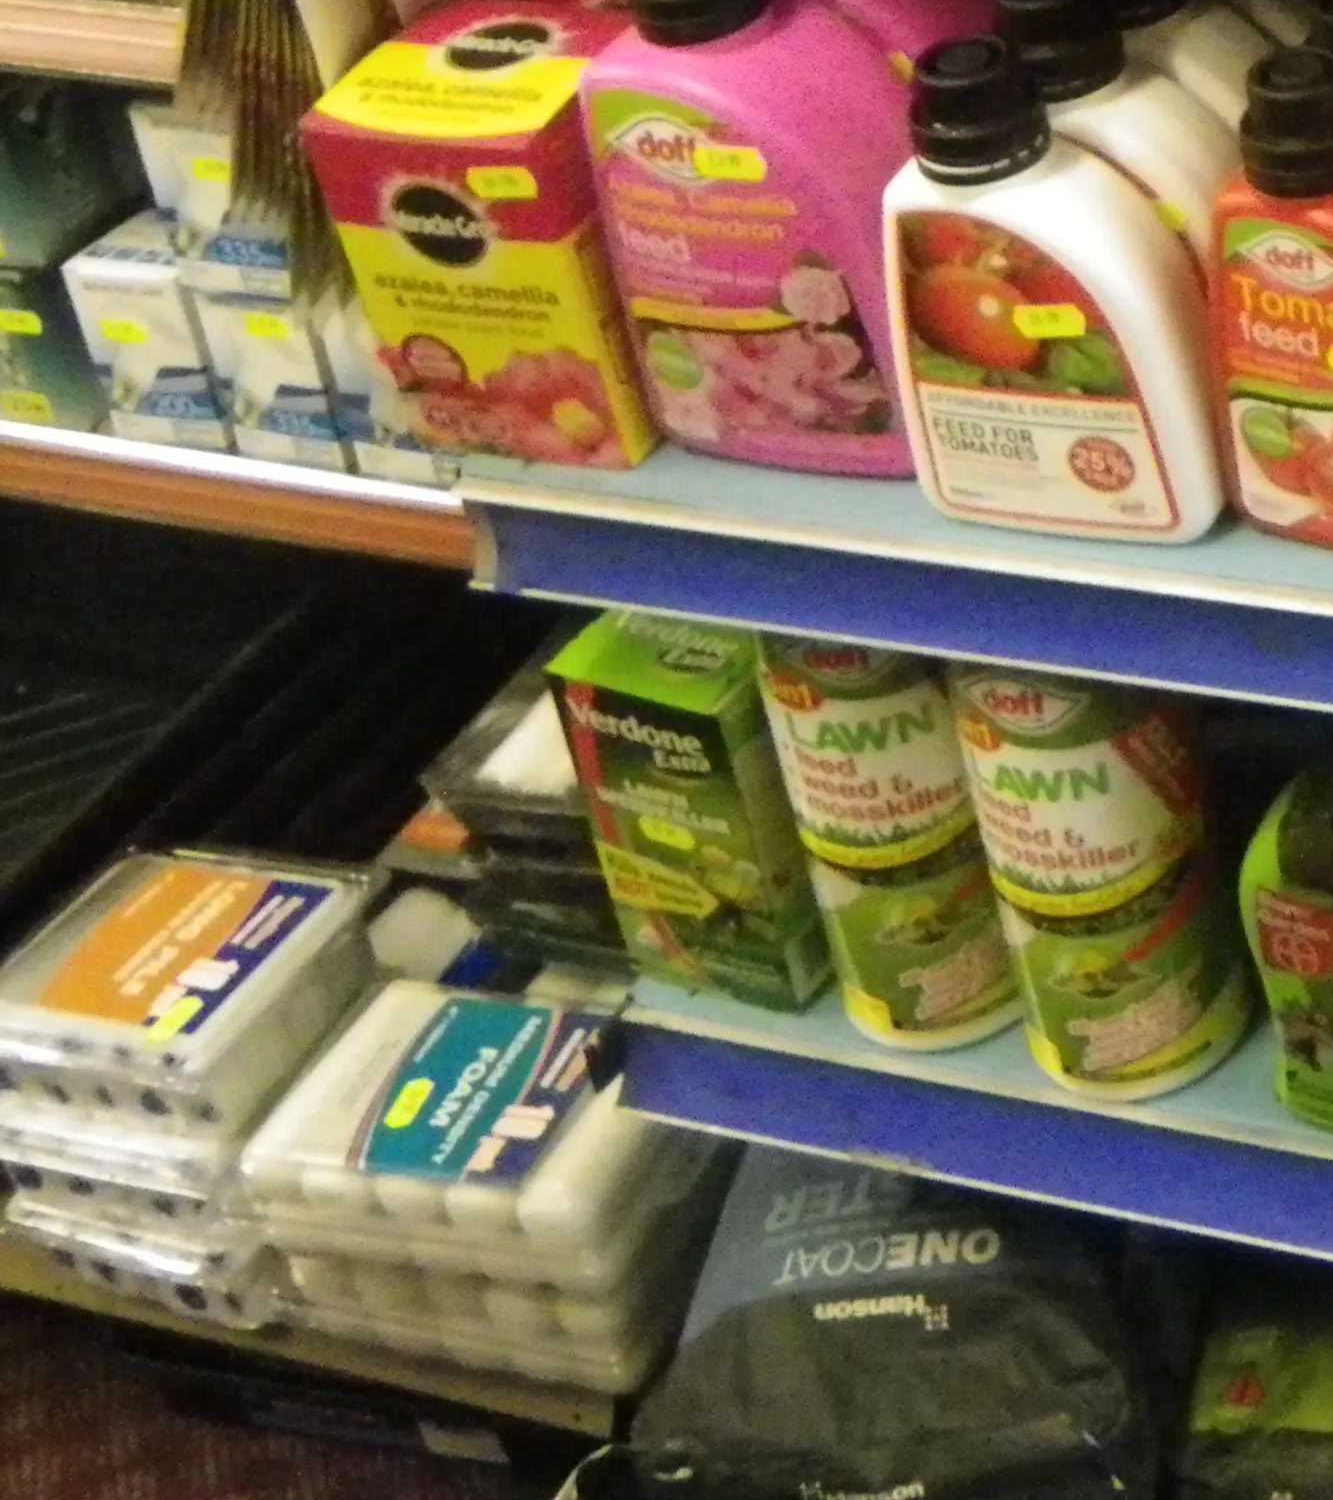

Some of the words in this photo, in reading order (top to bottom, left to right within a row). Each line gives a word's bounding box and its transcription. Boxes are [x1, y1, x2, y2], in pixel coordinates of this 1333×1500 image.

[1264, 245, 1317, 273] doff
[1238, 312, 1321, 358] feed
[932, 416, 986, 440] FEED
[990, 425, 1034, 447] FOR
[938, 433, 1040, 464] TOMATOES
[566, 695, 704, 752] Verdone
[784, 706, 935, 755] LAWN
[428, 1045, 500, 1128] FOAM
